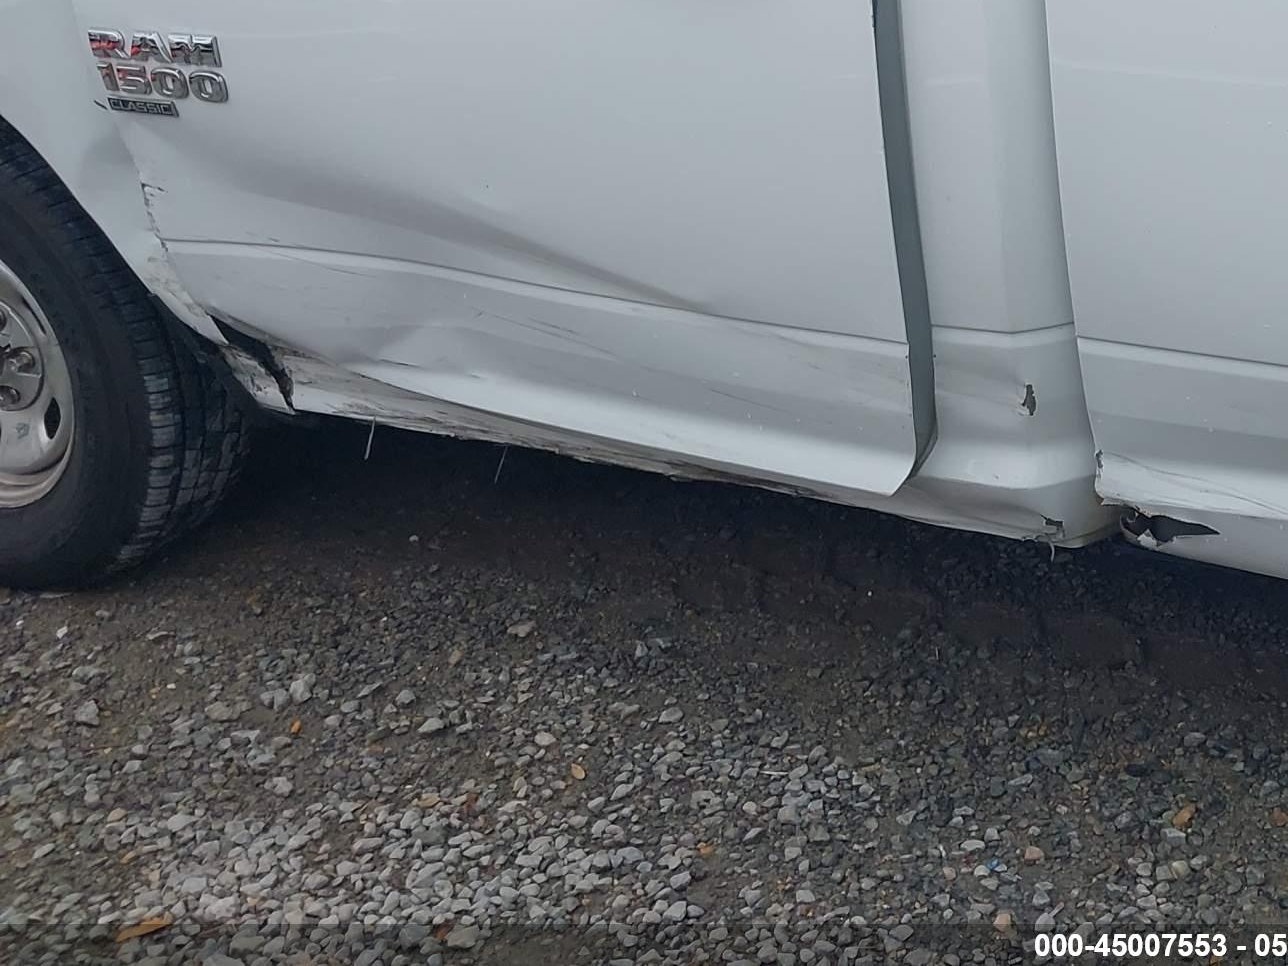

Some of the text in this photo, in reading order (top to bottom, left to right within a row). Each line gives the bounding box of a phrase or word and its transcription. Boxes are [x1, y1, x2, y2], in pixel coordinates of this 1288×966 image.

[87, 27, 222, 68] RAM
[96, 60, 229, 103] 1500
[109, 98, 175, 116] CLASSIC
